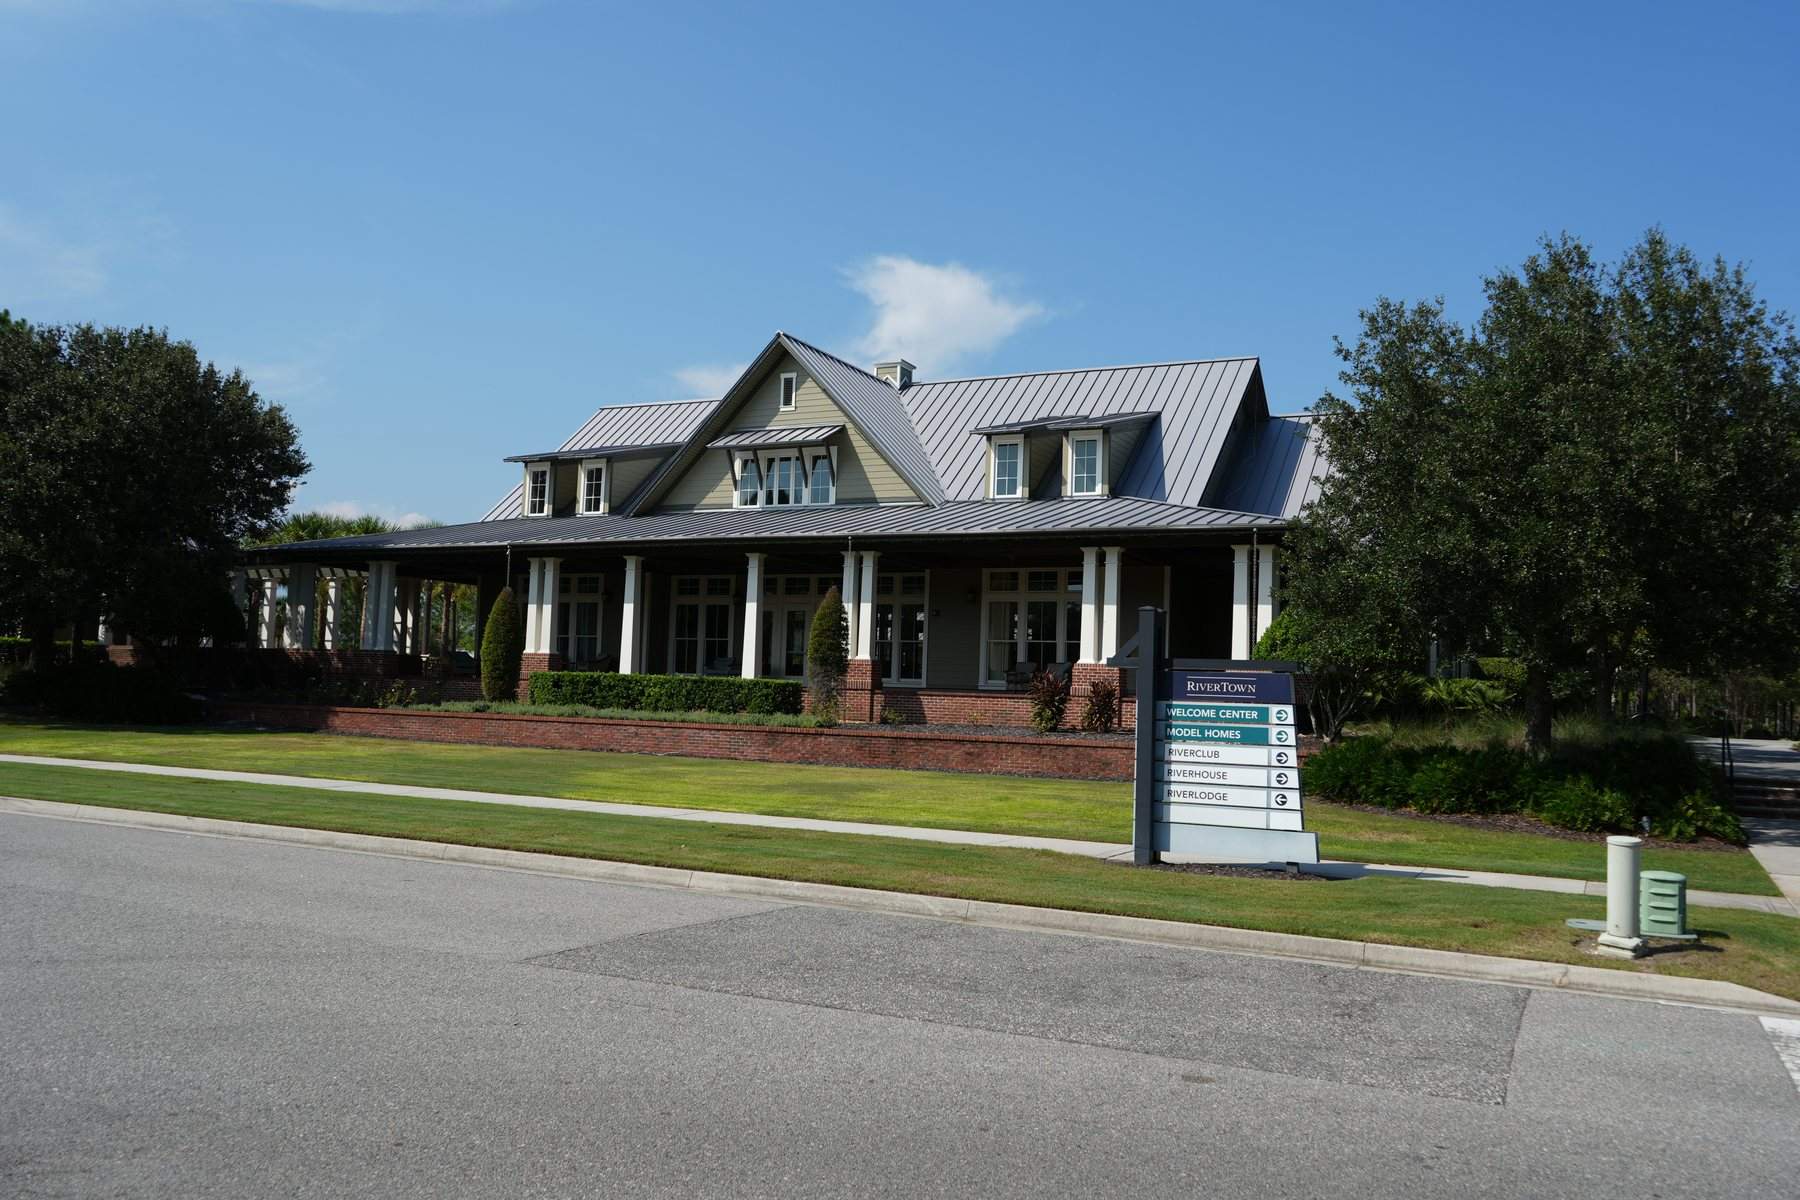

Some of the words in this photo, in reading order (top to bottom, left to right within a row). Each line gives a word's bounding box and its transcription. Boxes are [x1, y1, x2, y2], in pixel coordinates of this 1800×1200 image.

[1166, 708, 1217, 718] WELCOME
[1219, 709, 1258, 719] CENTER
[1166, 728, 1202, 737] MODEL
[1205, 729, 1241, 739] HOMES
[1168, 749, 1220, 759] RIVERCLUB
[1167, 769, 1228, 780] RIVERHOUSE
[1167, 790, 1228, 801] RIVERLODGE
